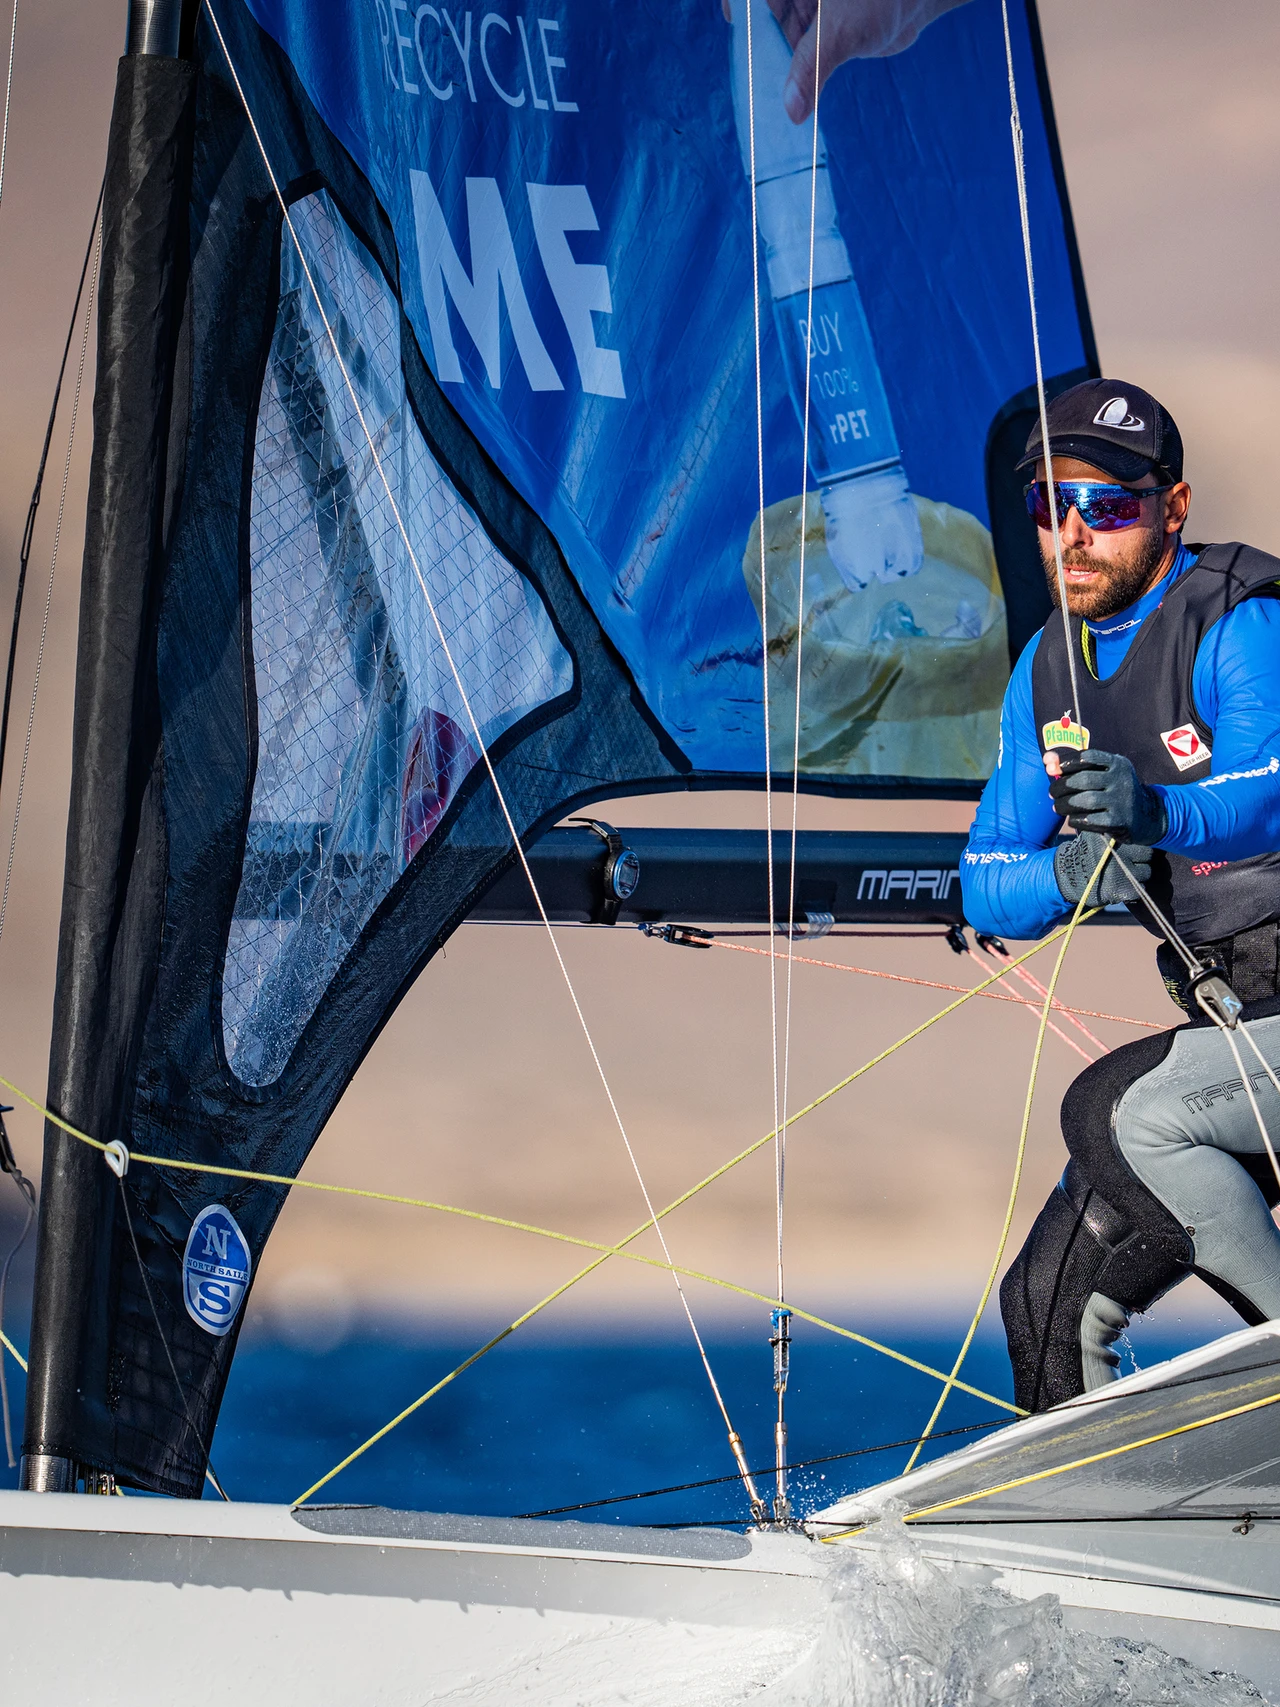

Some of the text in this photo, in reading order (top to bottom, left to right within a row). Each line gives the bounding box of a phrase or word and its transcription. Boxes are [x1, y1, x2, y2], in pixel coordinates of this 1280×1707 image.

[375, 0, 580, 112] RECYCLE
[409, 168, 627, 399] ME
[798, 311, 843, 358] BUY
[814, 367, 859, 400] 100%
[829, 408, 870, 444] rPET
[1196, 751, 1210, 762] HEER
[201, 1223, 232, 1260] N
[186, 1257, 217, 1273] NORTH
[198, 1280, 231, 1315] S
